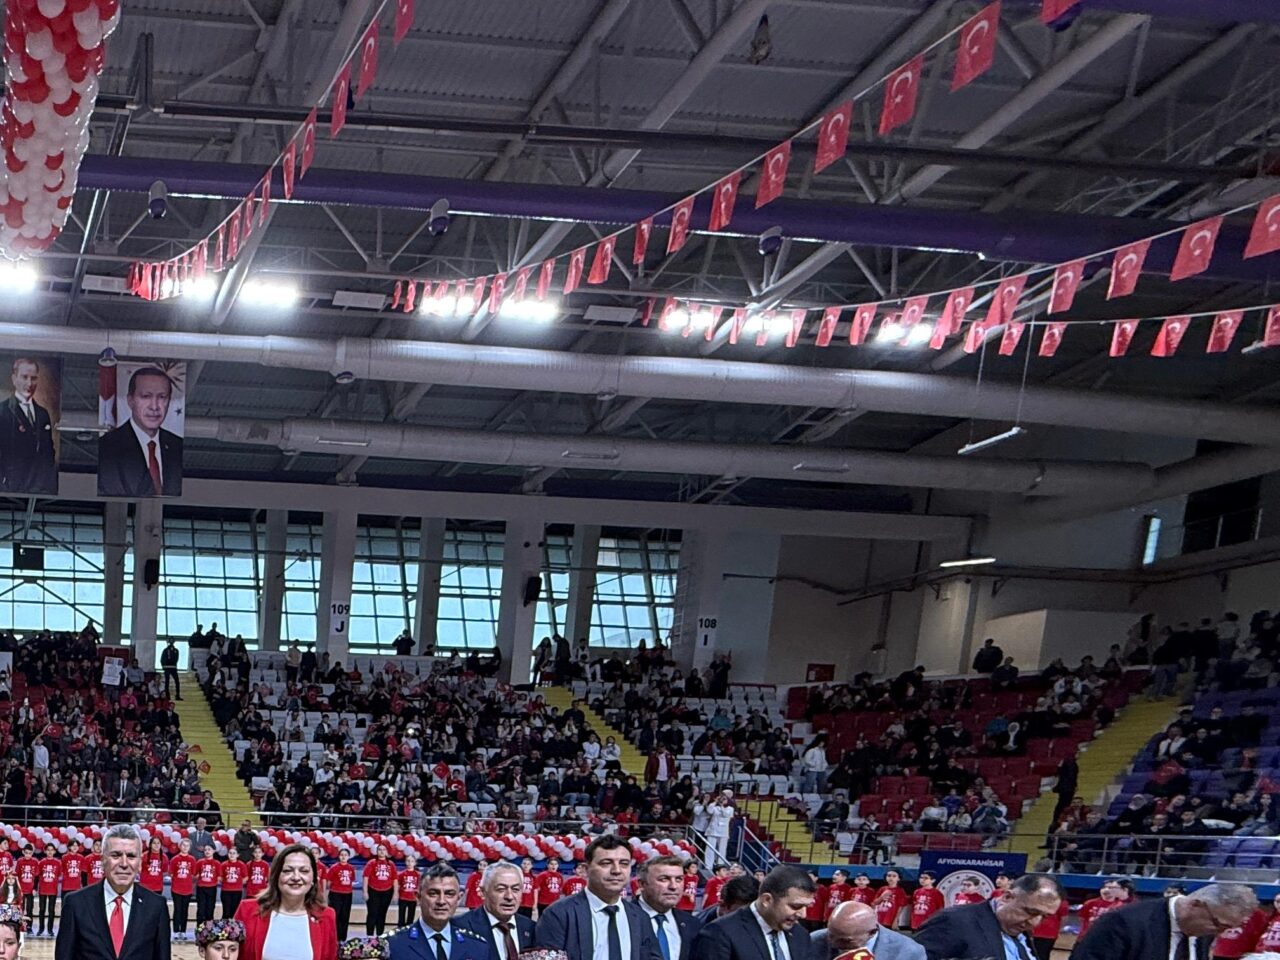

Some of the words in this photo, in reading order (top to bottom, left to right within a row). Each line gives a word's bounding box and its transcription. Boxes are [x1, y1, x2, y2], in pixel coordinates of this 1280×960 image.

[331, 603, 350, 615] 109
[335, 620, 345, 633] J
[699, 618, 717, 629] 108
